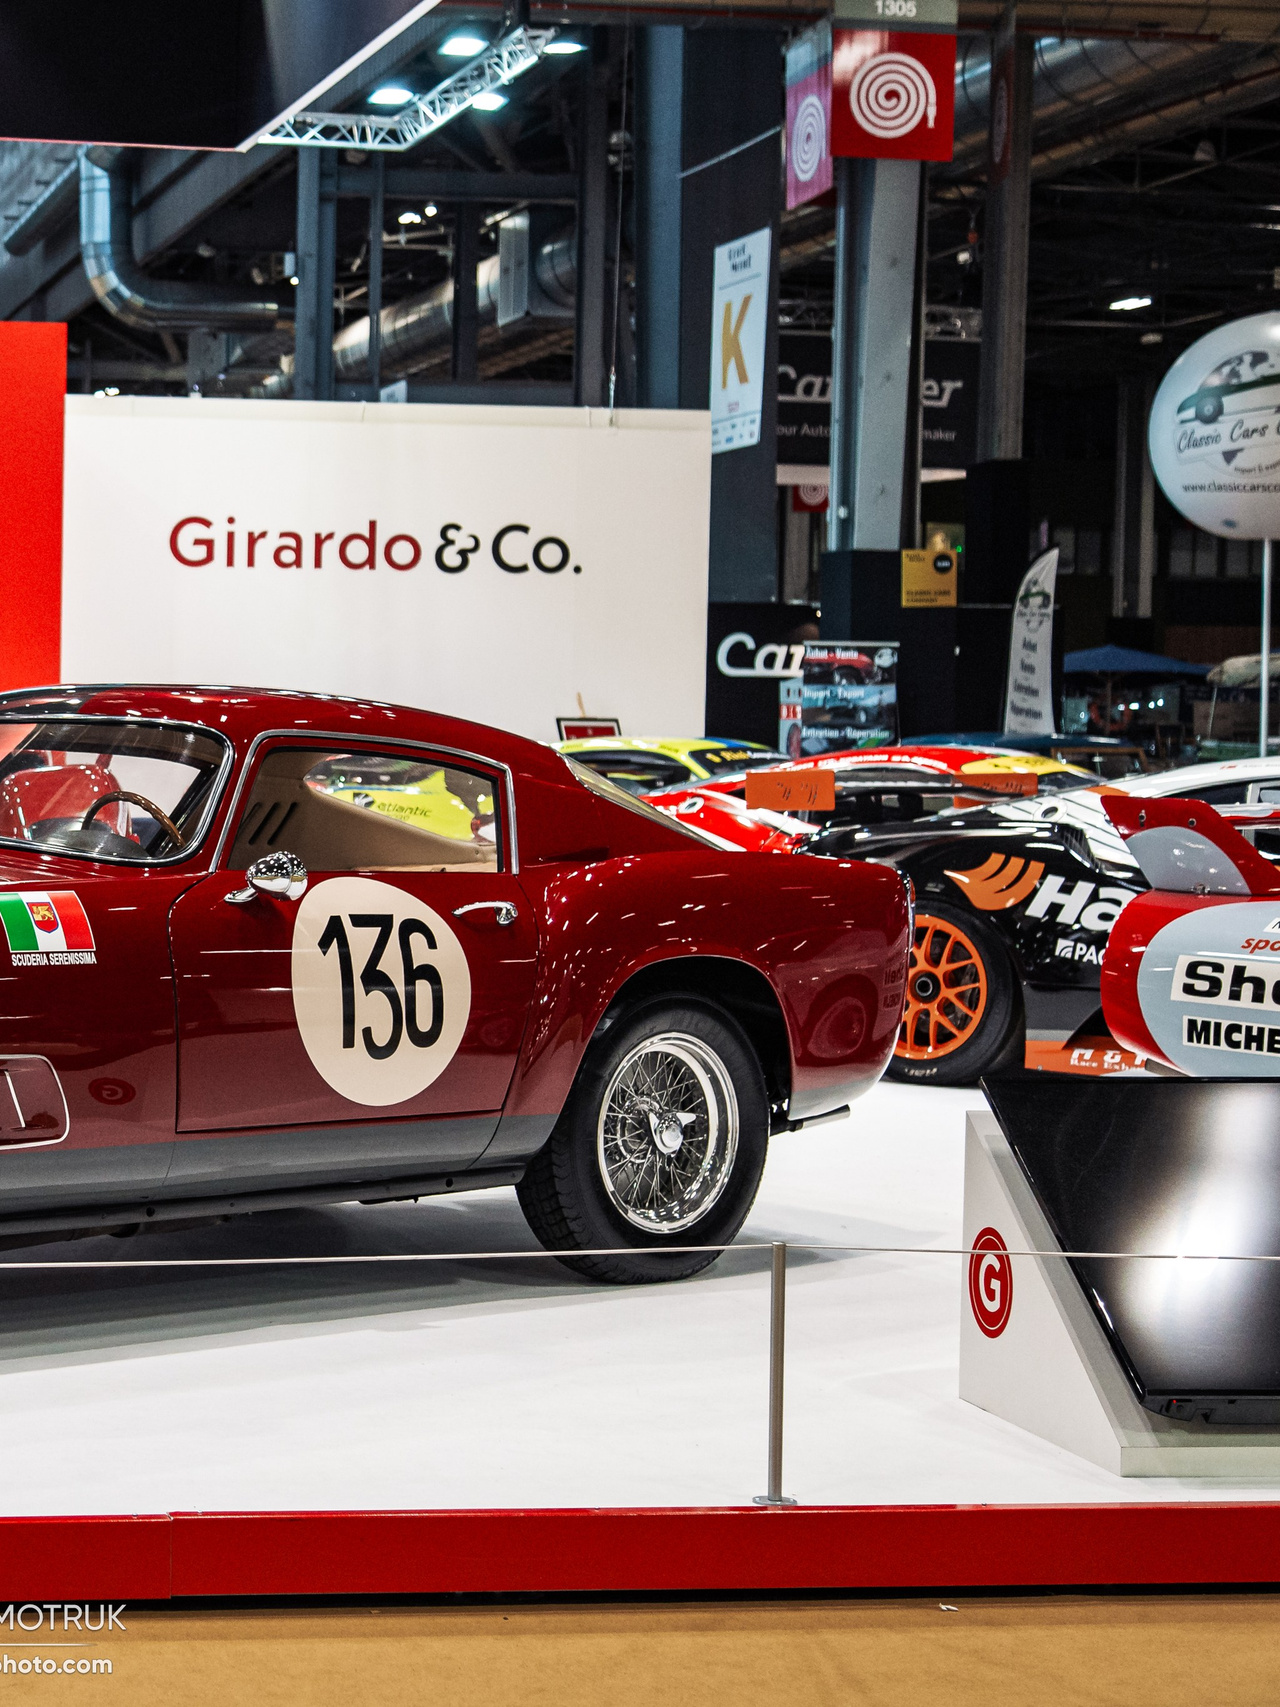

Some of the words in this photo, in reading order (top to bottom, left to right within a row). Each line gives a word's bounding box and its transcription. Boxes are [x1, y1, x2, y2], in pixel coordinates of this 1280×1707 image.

[876, 0, 917, 18] 1305
[722, 293, 753, 391] K
[1177, 428, 1222, 452] Classic
[1229, 419, 1269, 443] Cars
[169, 516, 423, 571] Girardo
[434, 523, 481, 575] &
[491, 523, 583, 575] Co.
[1024, 873, 1138, 933] Ha
[11, 953, 49, 966] SCUDERIA
[49, 952, 97, 965] SERENISSIMA
[1182, 960, 1280, 1006] Sh
[317, 914, 444, 1061] 136
[1187, 1018, 1280, 1054] MICHE
[979, 1253, 1001, 1313] G
